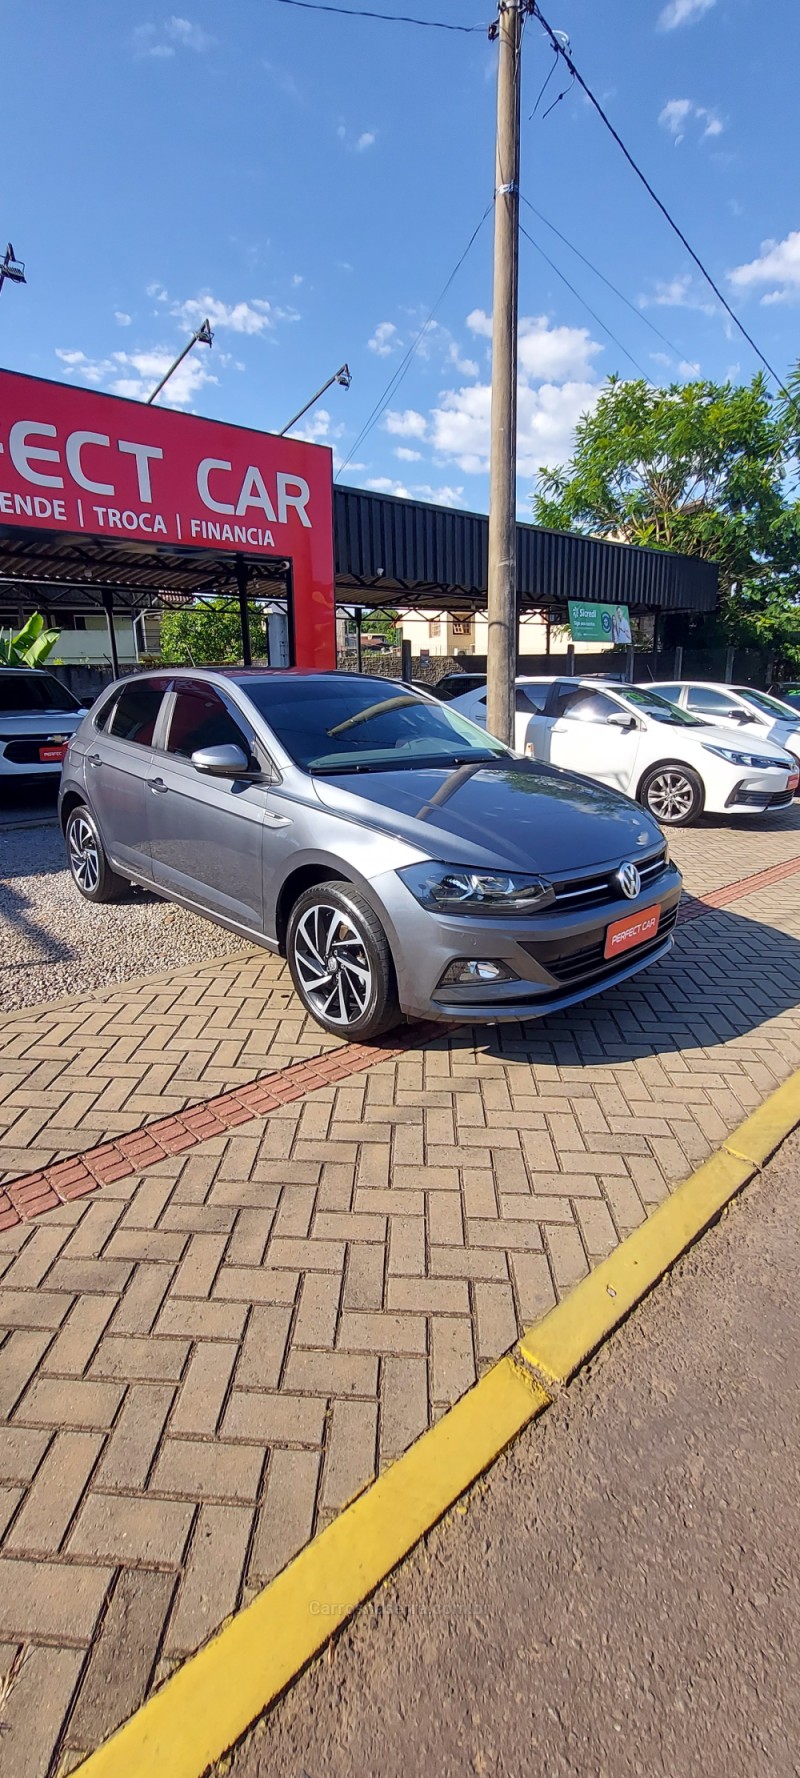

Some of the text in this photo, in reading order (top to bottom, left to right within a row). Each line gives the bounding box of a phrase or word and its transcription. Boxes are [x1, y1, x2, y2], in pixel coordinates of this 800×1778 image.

[0, 420, 312, 528] ECT CAR
[92, 506, 168, 534] TROCA
[190, 519, 275, 548] FINANCIA
[611, 917, 656, 946] PERFECT CAR
